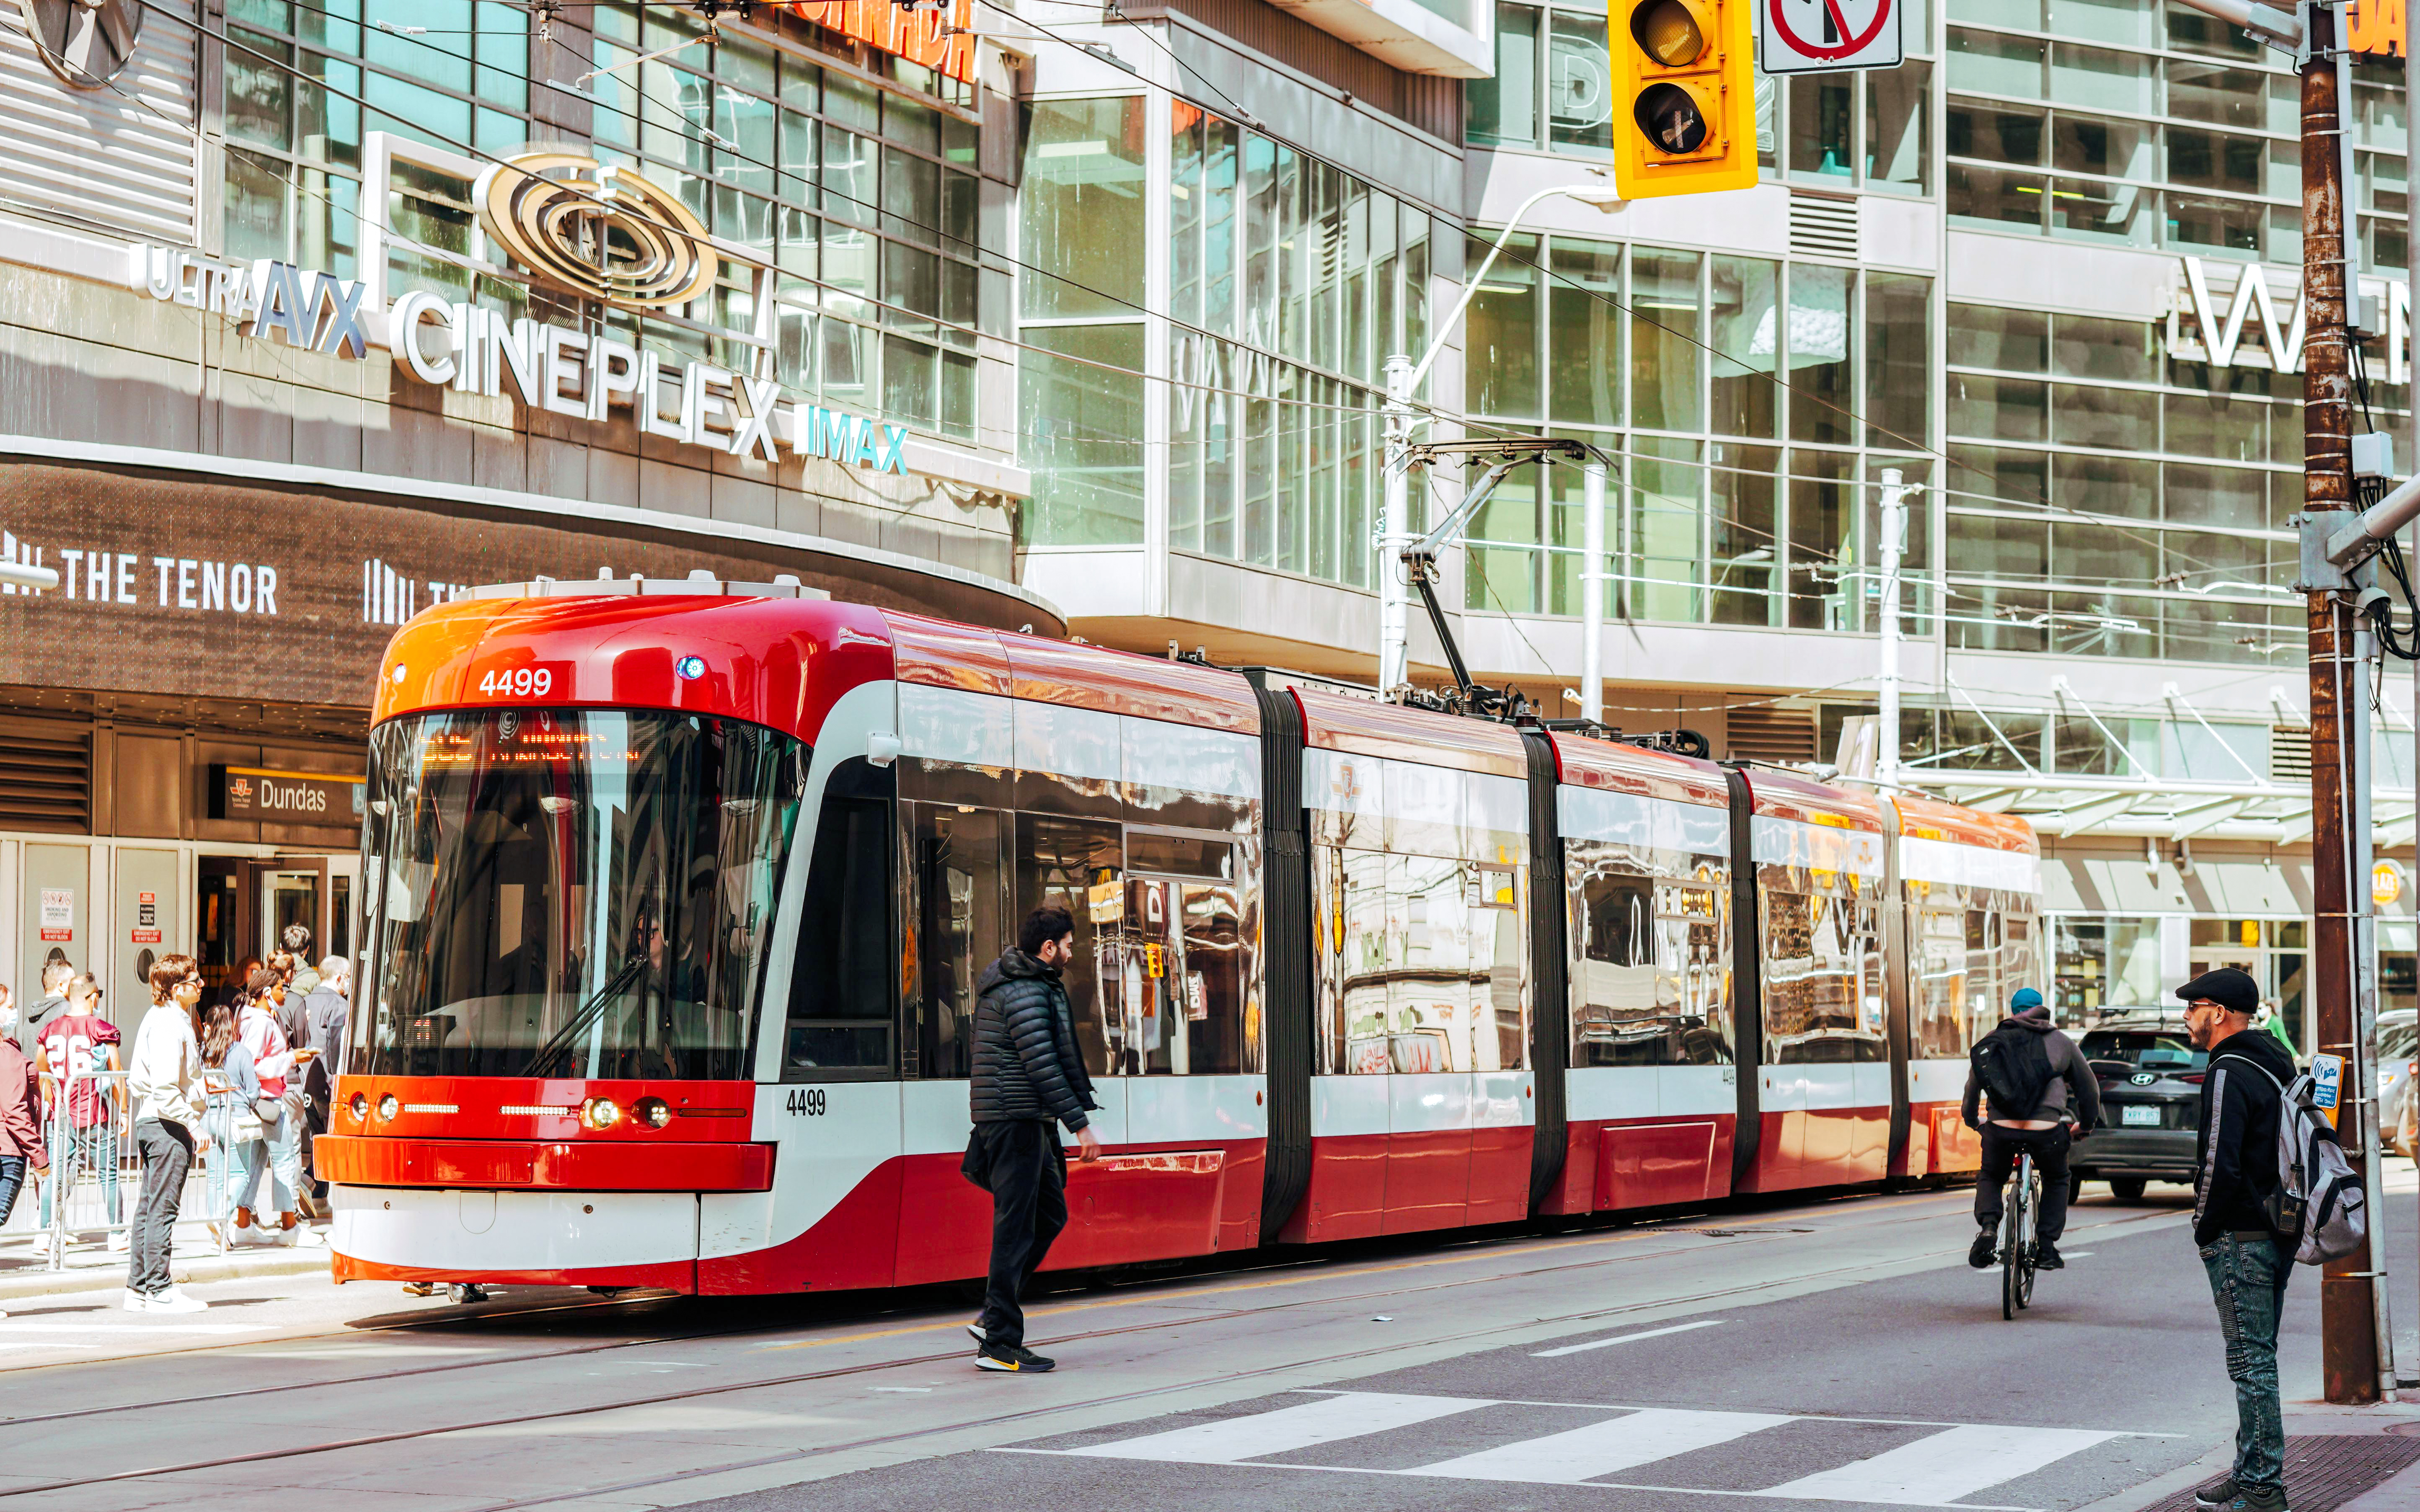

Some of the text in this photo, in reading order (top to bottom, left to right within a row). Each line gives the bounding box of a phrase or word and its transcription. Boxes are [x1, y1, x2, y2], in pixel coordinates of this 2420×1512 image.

[130, 243, 367, 361] ULTRA AVX
[390, 291, 781, 463] CINEPLEX
[794, 403, 909, 476] IMAX
[61, 549, 278, 615] THE TENOR
[479, 668, 552, 697] 4499
[261, 779, 326, 812] Dundas
[2372, 872, 2396, 891] LAZE
[46, 1035, 93, 1079] 26
[786, 1089, 825, 1116] 4499
